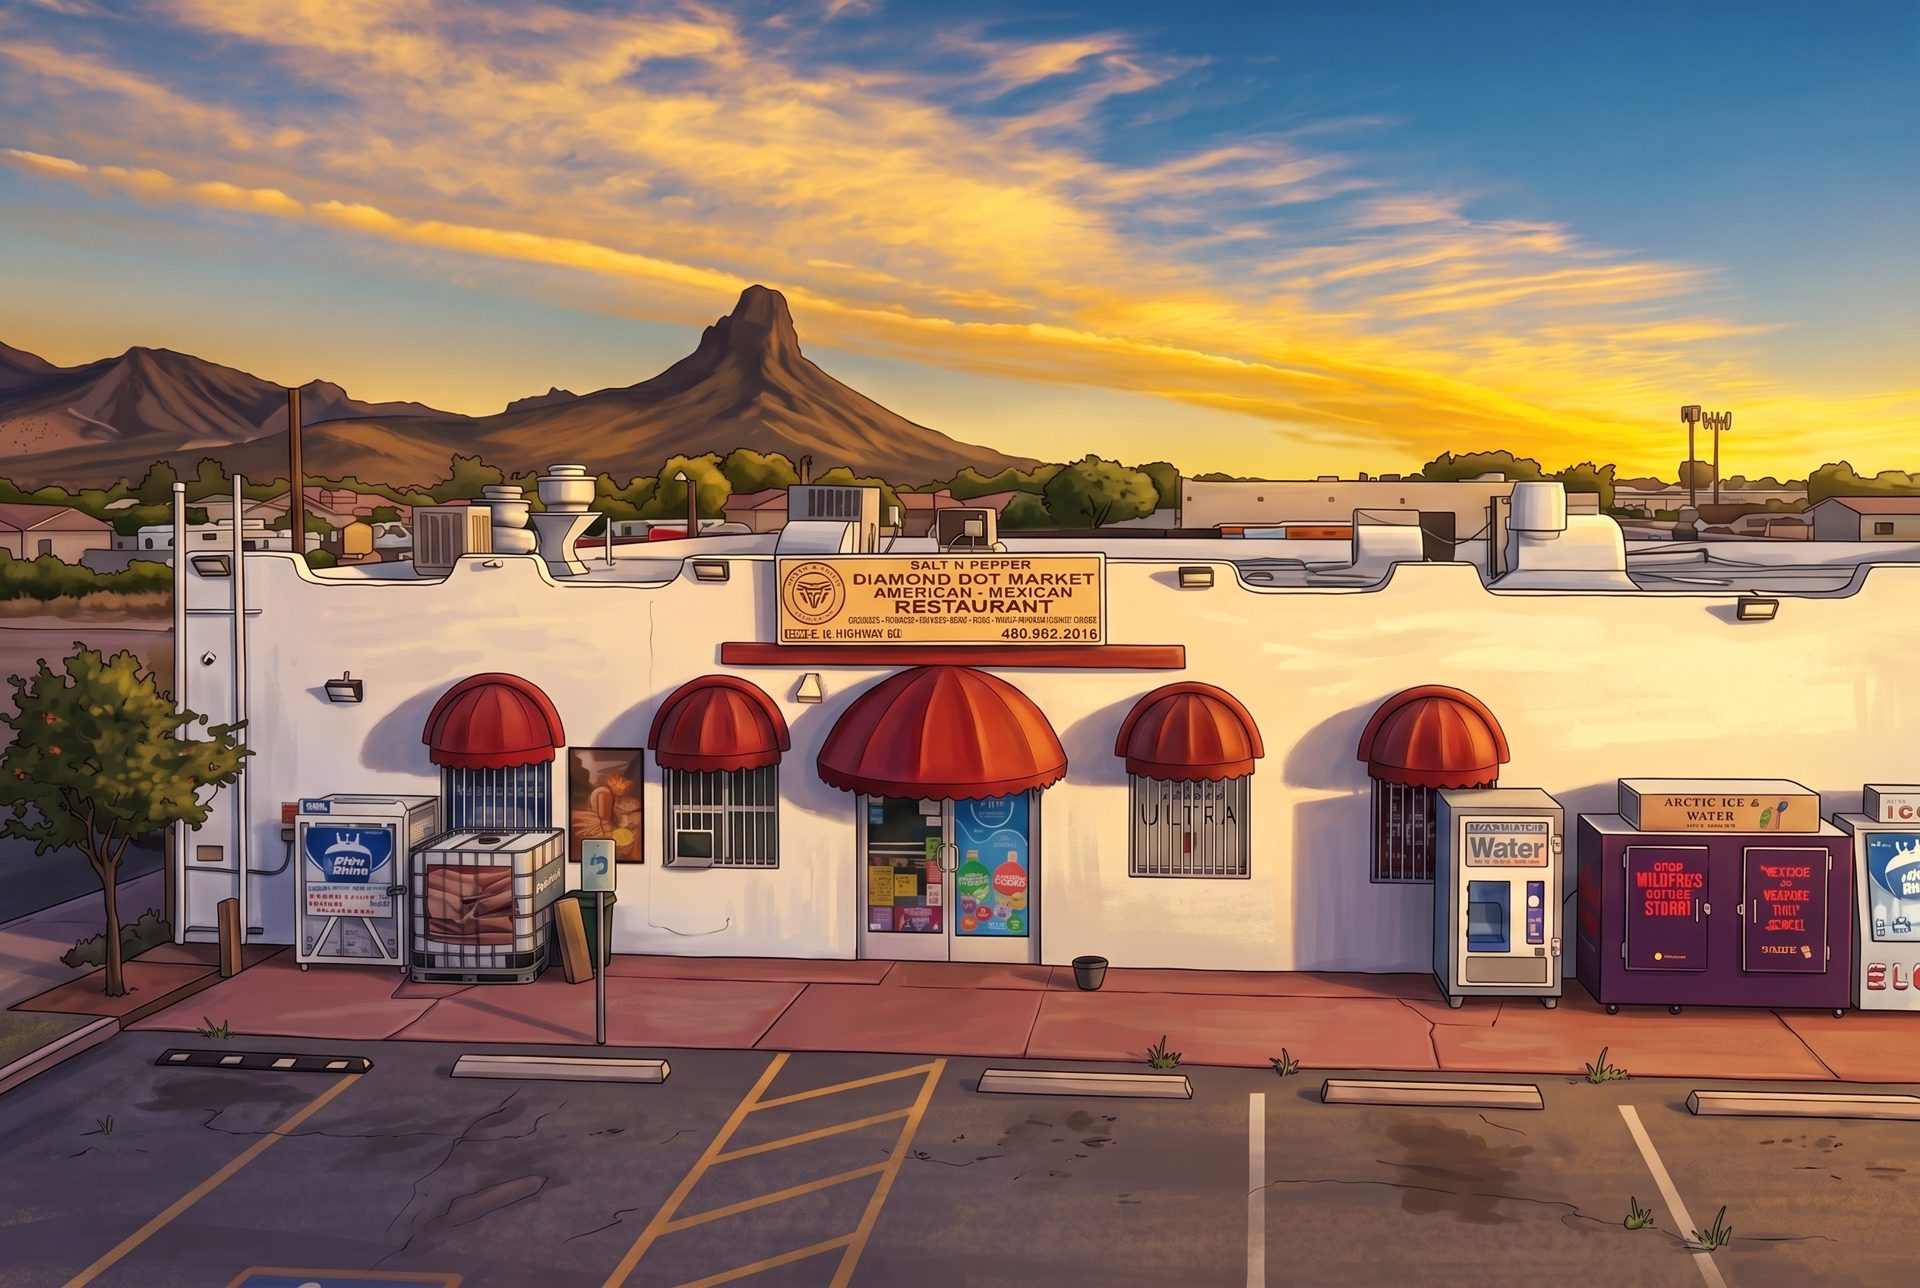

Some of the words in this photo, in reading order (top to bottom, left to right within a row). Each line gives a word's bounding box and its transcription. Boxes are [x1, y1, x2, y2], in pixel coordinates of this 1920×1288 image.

[910, 560, 948, 570] SALT
[954, 560, 964, 570] N
[970, 560, 1031, 570] PEPPER
[853, 573, 951, 586] DIAMOND
[958, 573, 1001, 586] DOT
[1008, 573, 1095, 586] MARKET
[873, 587, 973, 599] AMERICAN
[988, 587, 1073, 598] MEXICAN
[894, 599, 1054, 614] RESTAURANT
[835, 628, 883, 639] HIGHWAY
[1001, 628, 1098, 640] 480.962.2016
[1664, 798, 1716, 807] ARCTIC
[1722, 798, 1745, 807] ICE
[1141, 804, 1237, 826] ULTRA
[1686, 811, 1734, 821] WATER
[1887, 805, 1920, 820] IC
[1470, 837, 1545, 859] Water
